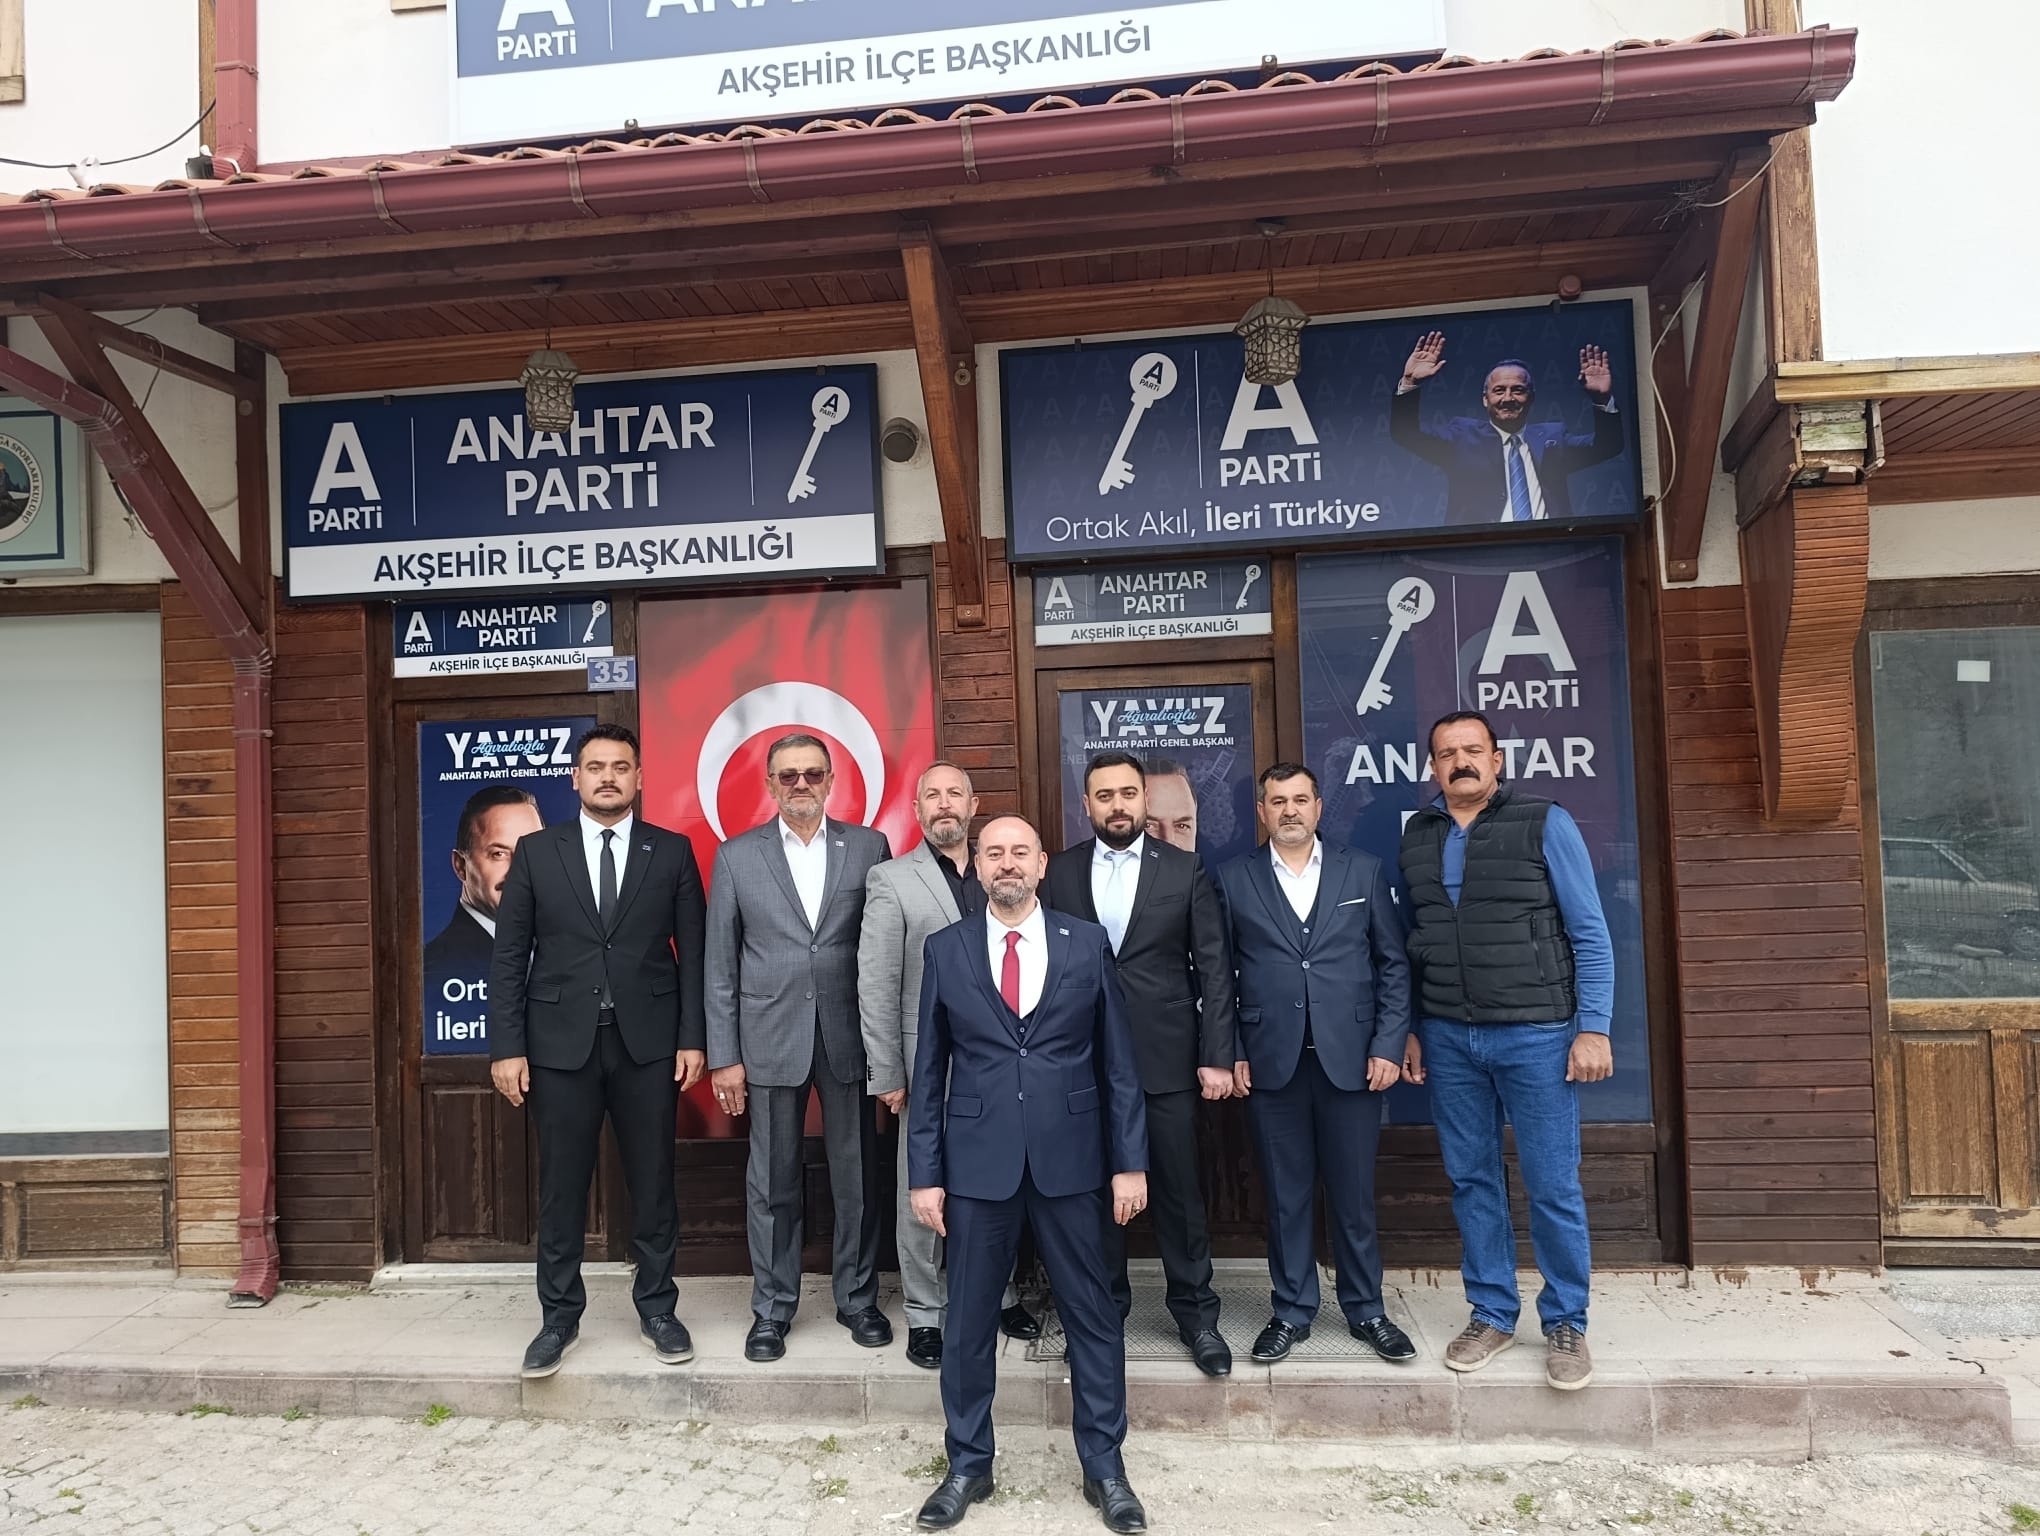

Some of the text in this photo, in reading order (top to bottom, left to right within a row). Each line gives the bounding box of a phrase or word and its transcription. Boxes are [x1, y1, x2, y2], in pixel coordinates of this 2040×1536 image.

[717, 19, 1151, 98] AKŞEHİR İLÇE BAŞKANLIĞI
[1143, 361, 1163, 384] A
[822, 393, 839, 413] A
[1219, 374, 1320, 451] A
[447, 402, 715, 464] ANAHTAR
[308, 422, 381, 504] A
[1045, 498, 1381, 542] Ortak Akıl, İleri Türkiye
[373, 526, 794, 587] AKŞEHİR İLÇE BAŞKANLIĞI
[1044, 577, 1074, 609] A
[1099, 570, 1208, 595] ANAHTAR
[1400, 585, 1422, 609] A
[404, 611, 433, 643] A
[456, 605, 558, 628] ANAHTAR
[1070, 617, 1239, 642] AKŞEHİR İLÇE BAŞKANLIĞI
[1477, 570, 1578, 675] A
[429, 650, 586, 674] AKŞEHİR İLÇE BAŞKANLIĞI
[594, 661, 629, 683] 35
[1090, 696, 1226, 738] YAVUZ
[445, 727, 572, 769] YAVUZ
[1083, 739, 1129, 751] ANAHTAR
[1160, 738, 1191, 748] GENEL
[1192, 736, 1234, 749] BAŞKANI
[439, 770, 482, 782] ANAHTAR
[511, 767, 539, 778] GENEL
[540, 766, 574, 778] BAŞKA
[1345, 736, 1597, 785] ANTAR
[442, 978, 488, 1002] Ort
[436, 1010, 486, 1040] İleri
